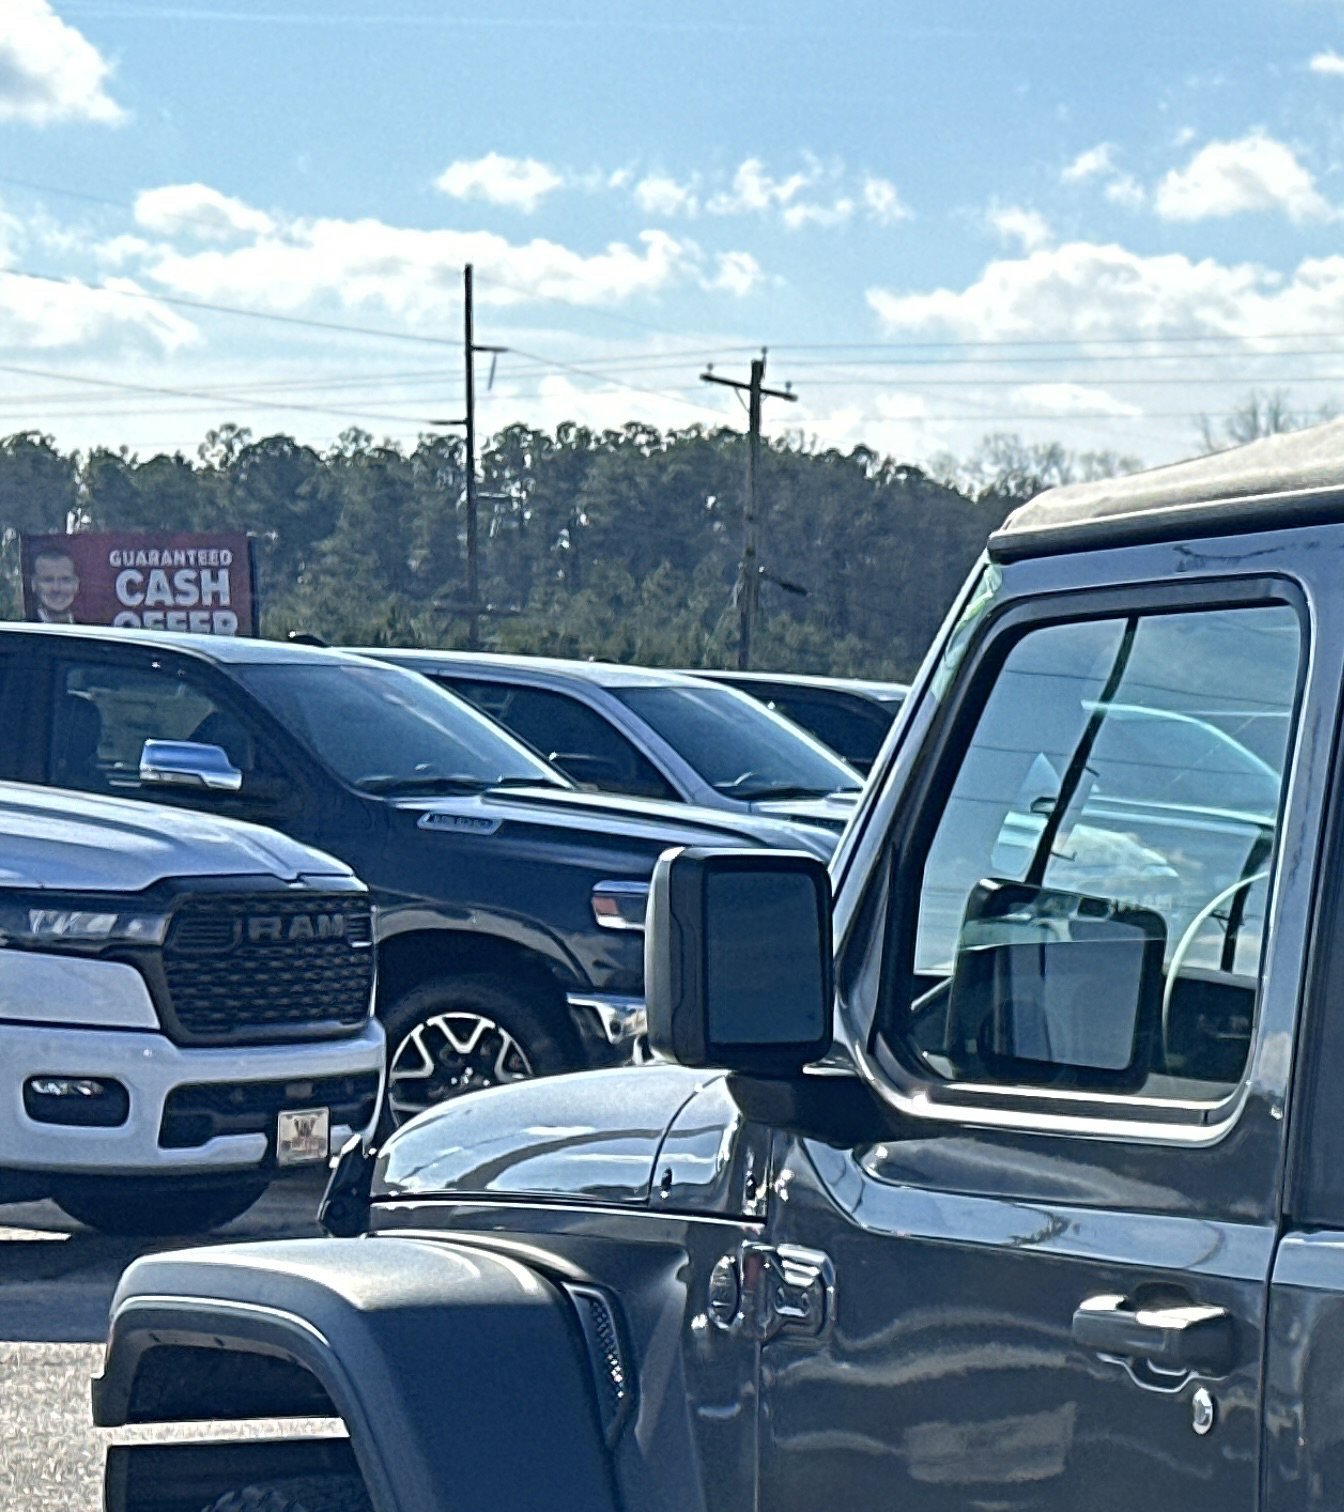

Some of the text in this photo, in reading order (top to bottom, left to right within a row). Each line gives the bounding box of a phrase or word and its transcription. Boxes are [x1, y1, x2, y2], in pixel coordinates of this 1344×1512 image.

[109, 549, 233, 568] GUARANTEED
[115, 568, 232, 607] CASH
[248, 913, 344, 941] RAM
